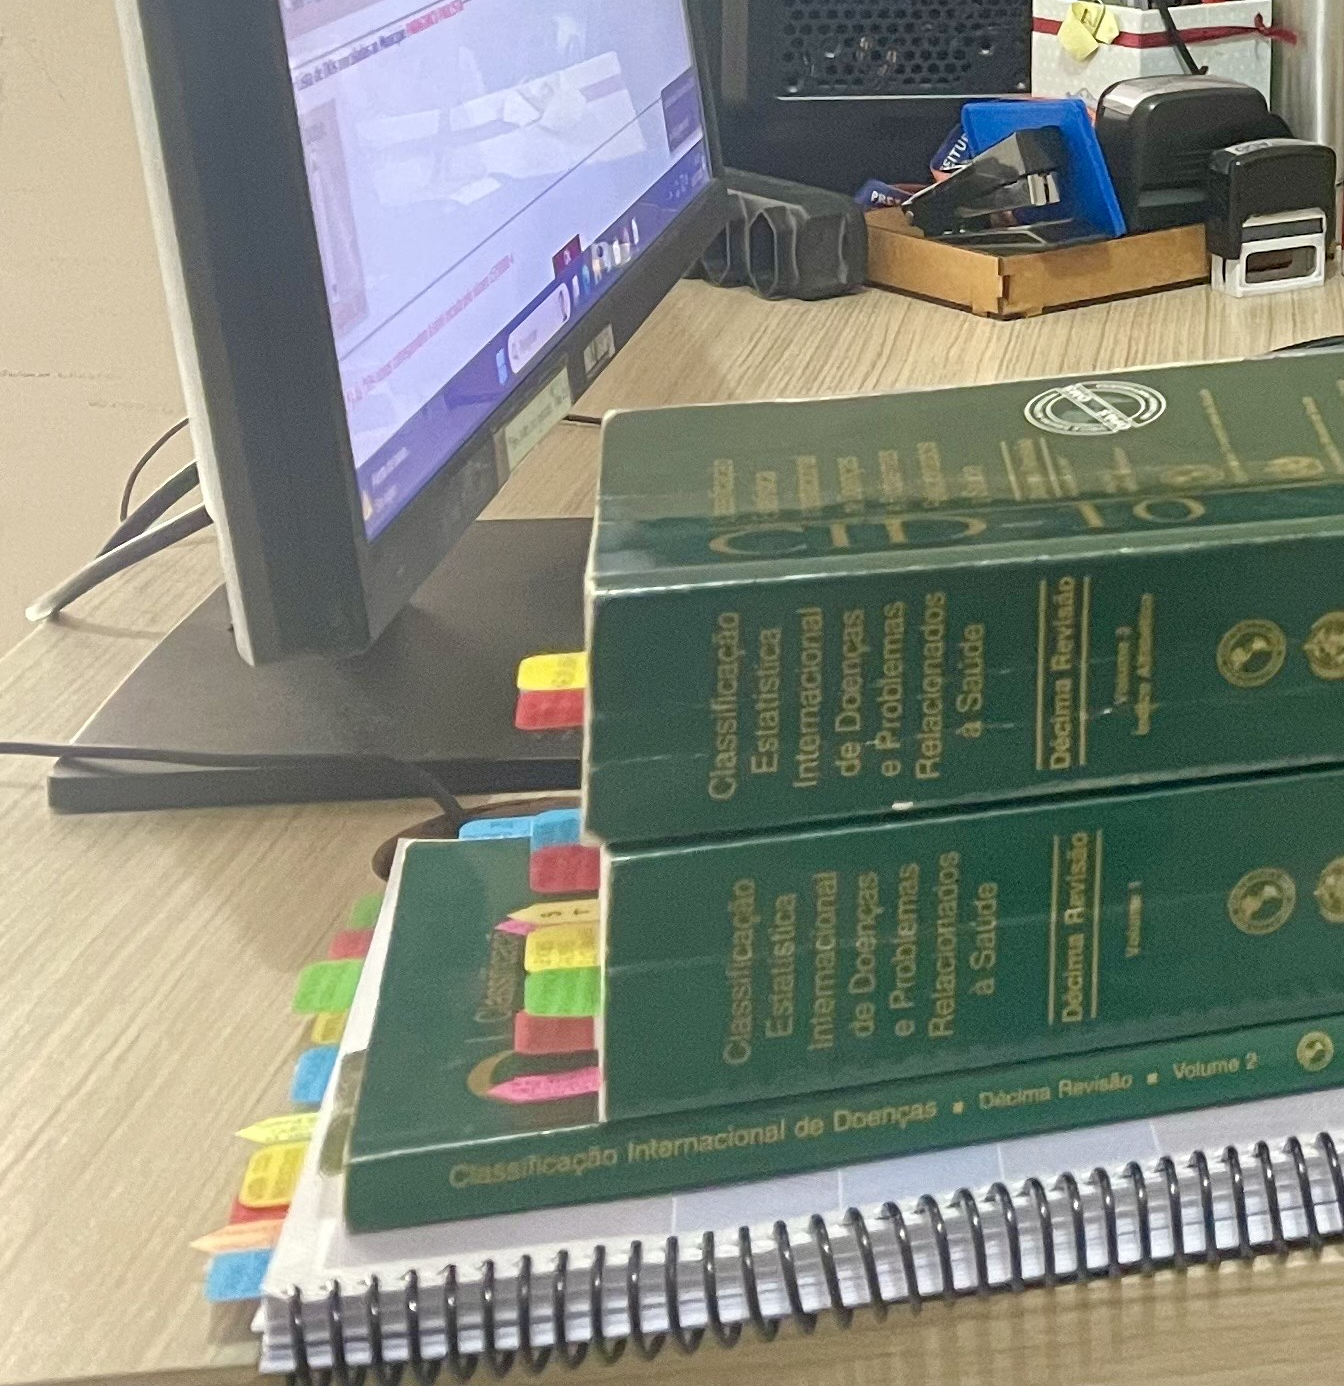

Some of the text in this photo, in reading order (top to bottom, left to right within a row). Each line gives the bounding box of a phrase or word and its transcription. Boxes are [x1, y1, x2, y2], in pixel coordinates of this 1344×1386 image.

[708, 612, 746, 800] Classificação
[751, 627, 782, 774] Estatística
[793, 606, 824, 787] Internacional
[835, 609, 870, 777] de Doenças
[874, 601, 905, 778] e Problemas
[915, 592, 947, 779] Relacionados
[955, 622, 986, 712] Saúde
[1050, 576, 1077, 770] Décima Revisão
[723, 878, 761, 1064] Classificação
[765, 893, 797, 1038] Estatística
[807, 870, 838, 1050] Internacional
[848, 871, 885, 1038] de Doenças
[889, 862, 919, 1038] e Problemas
[928, 850, 960, 1038] Relacionados
[969, 882, 999, 971] Saúde
[1061, 831, 1089, 1023] Décima Revisão
[449, 1051, 1258, 1189] Classificação Internacional de Doenças Décima Revisão Volume 2
